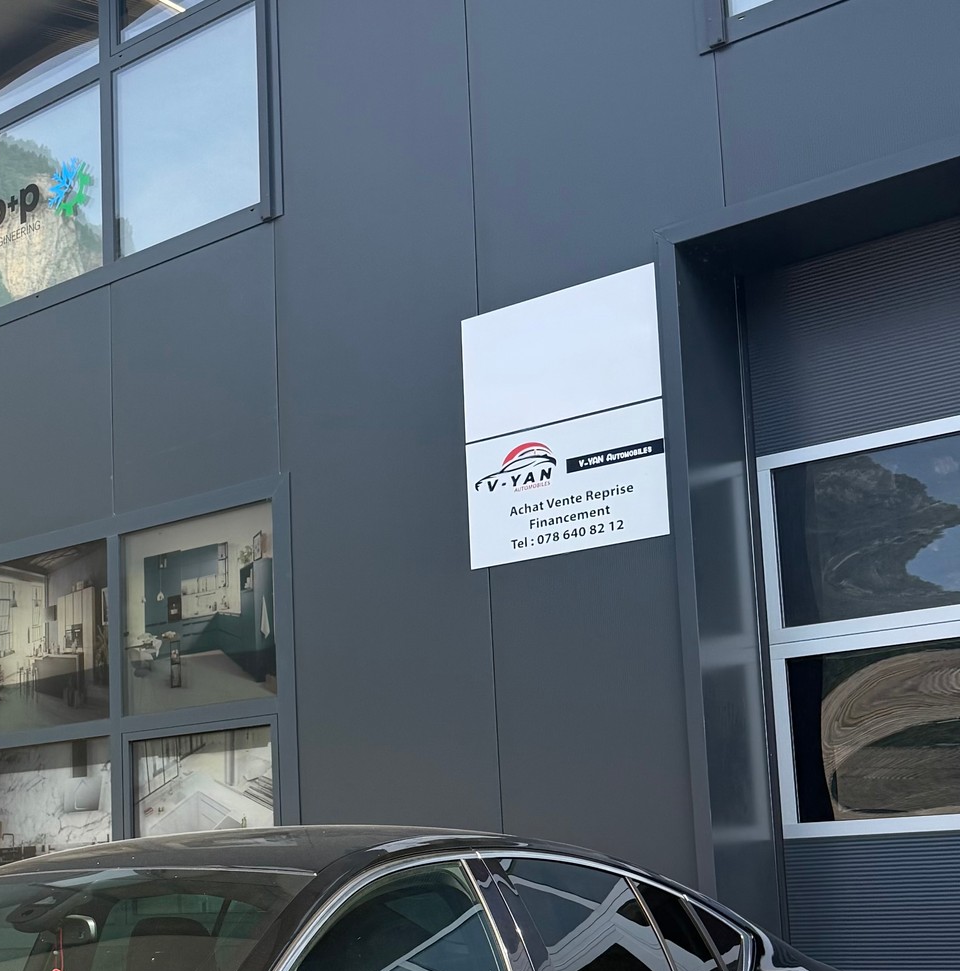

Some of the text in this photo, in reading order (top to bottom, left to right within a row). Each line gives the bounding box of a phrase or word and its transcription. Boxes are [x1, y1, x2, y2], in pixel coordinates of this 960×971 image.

[514, 481, 551, 493] AUTOMOBILES
[509, 483, 634, 517] Achat Vente Reprise
[529, 505, 611, 530] Financement
[537, 532, 560, 545] 078
[563, 527, 586, 540] 640
[589, 523, 605, 535] 82
[609, 519, 624, 532] 12
